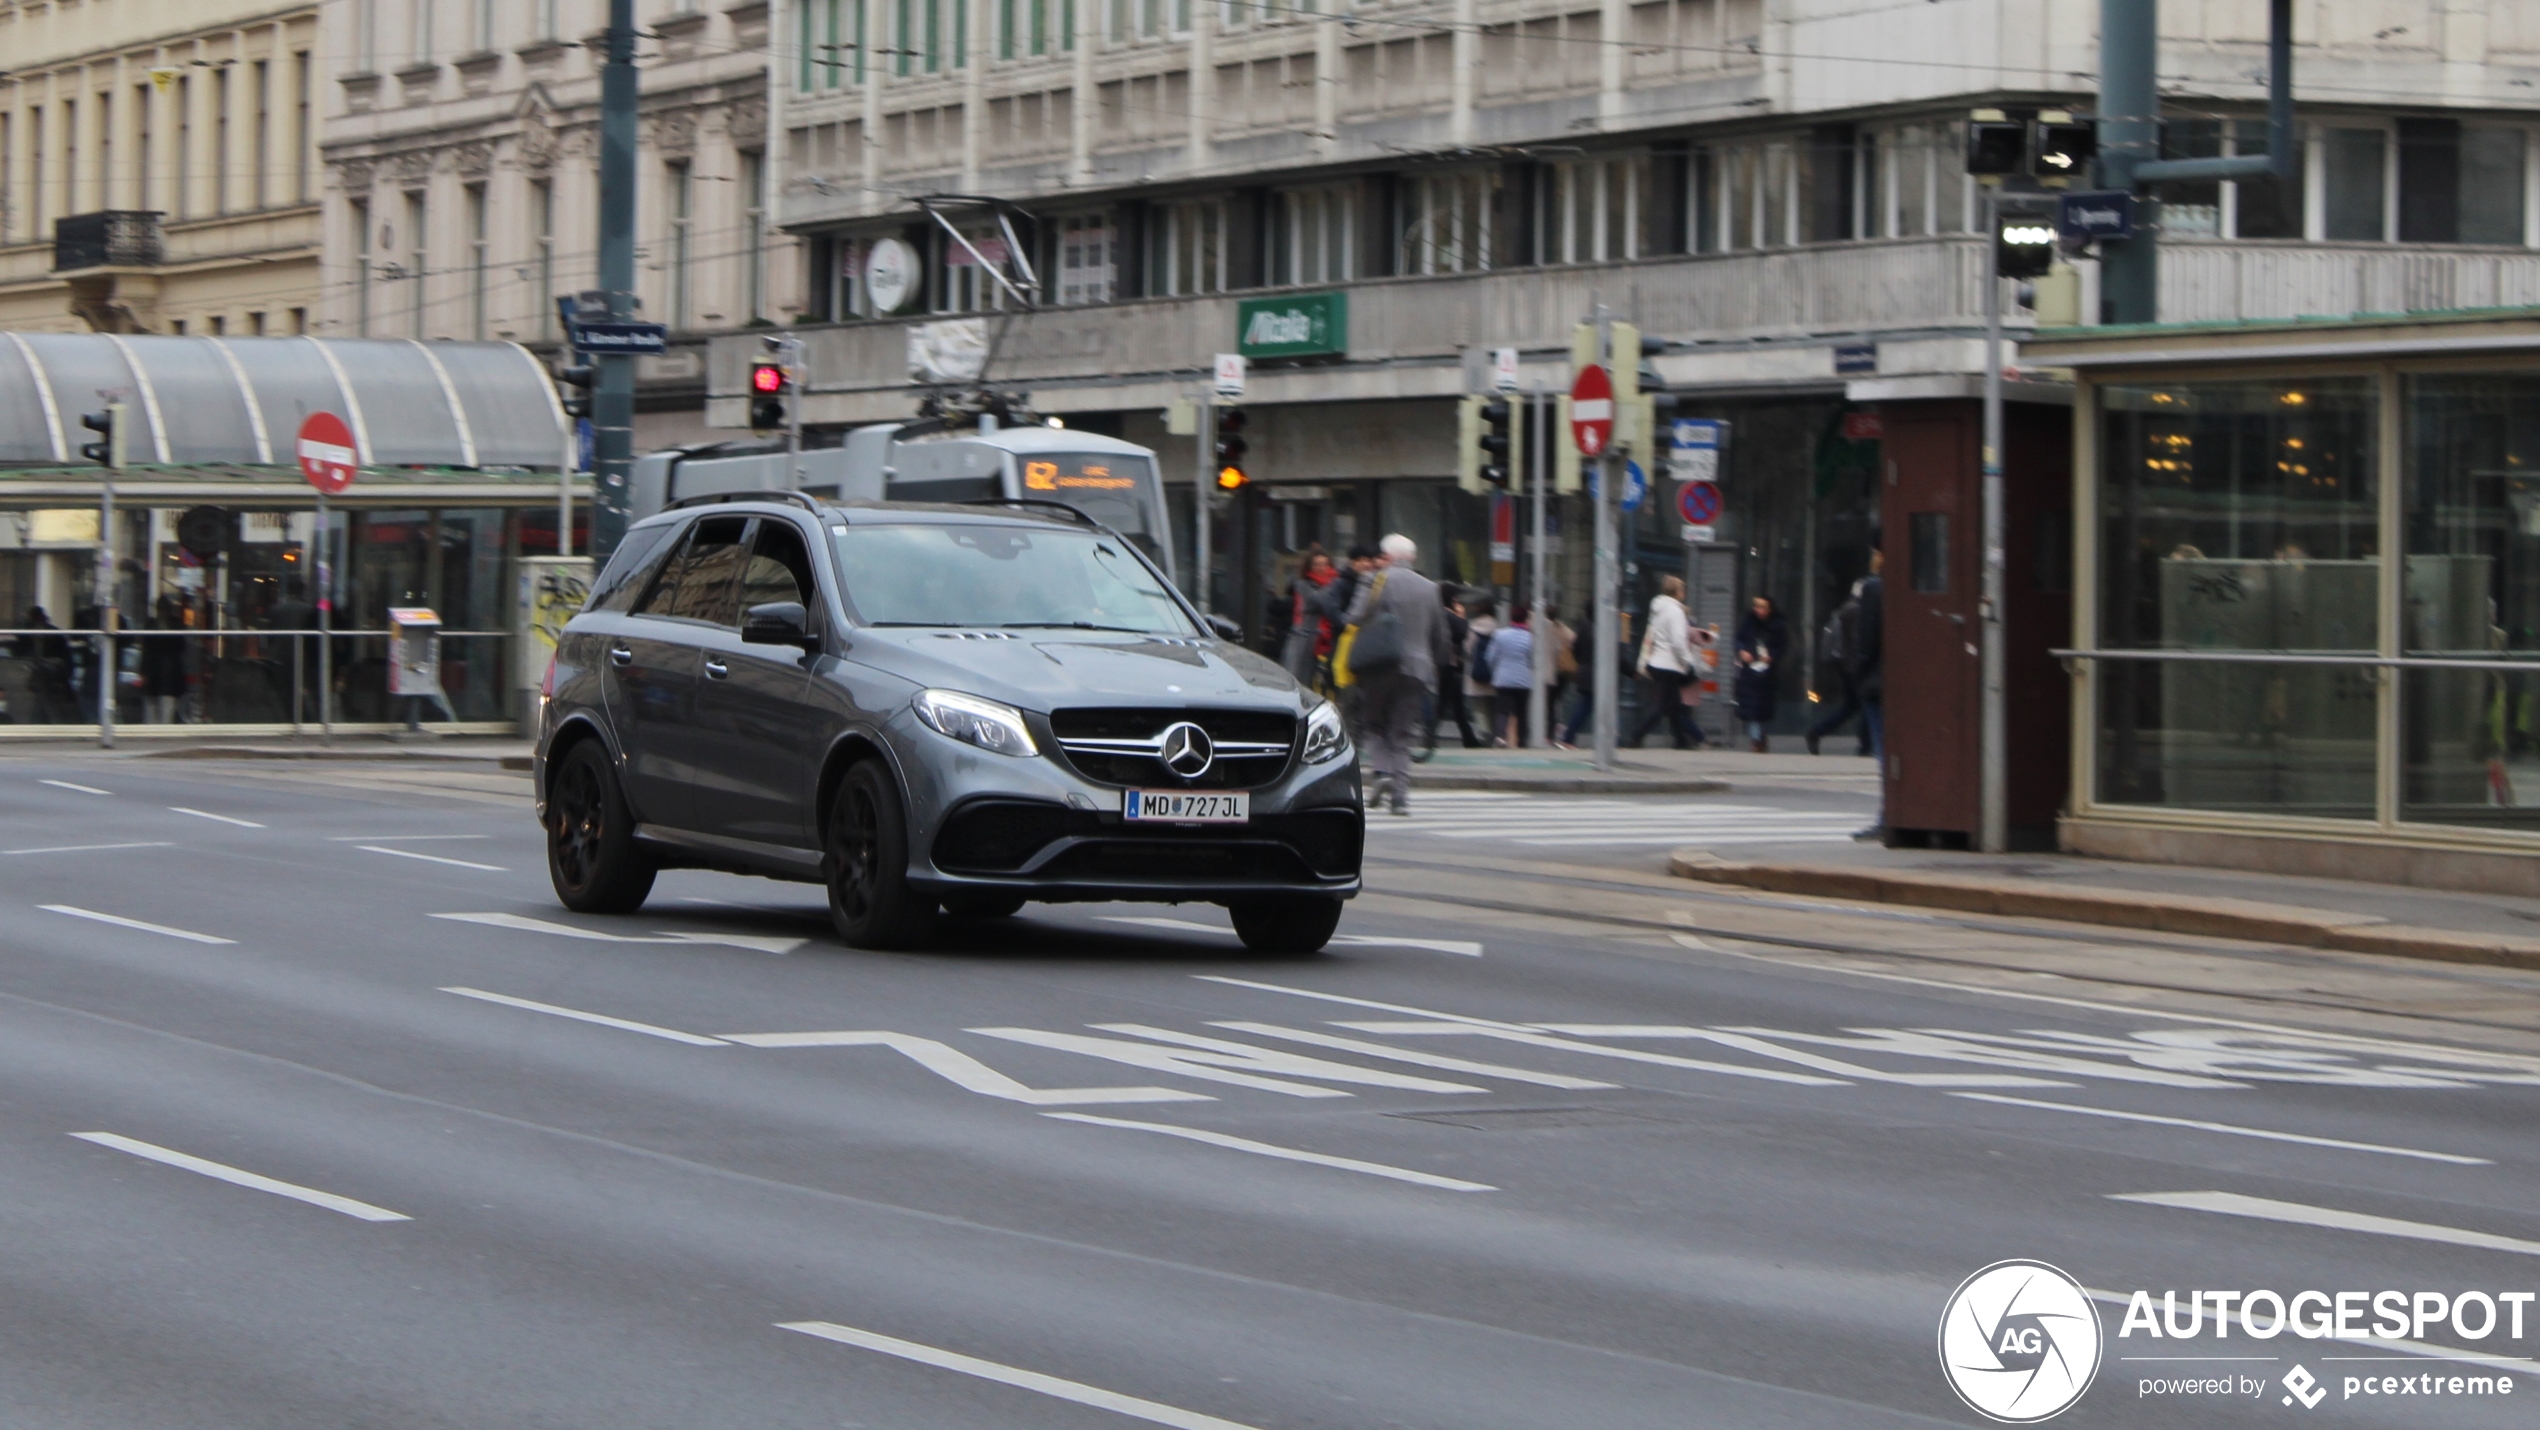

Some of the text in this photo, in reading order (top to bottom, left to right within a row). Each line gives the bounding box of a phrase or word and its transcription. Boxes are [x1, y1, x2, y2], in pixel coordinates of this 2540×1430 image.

[1025, 461, 1058, 490] 62
[1144, 795, 1169, 816] MD
[1185, 797, 1218, 817] 727
[1222, 797, 1241, 817] JL
